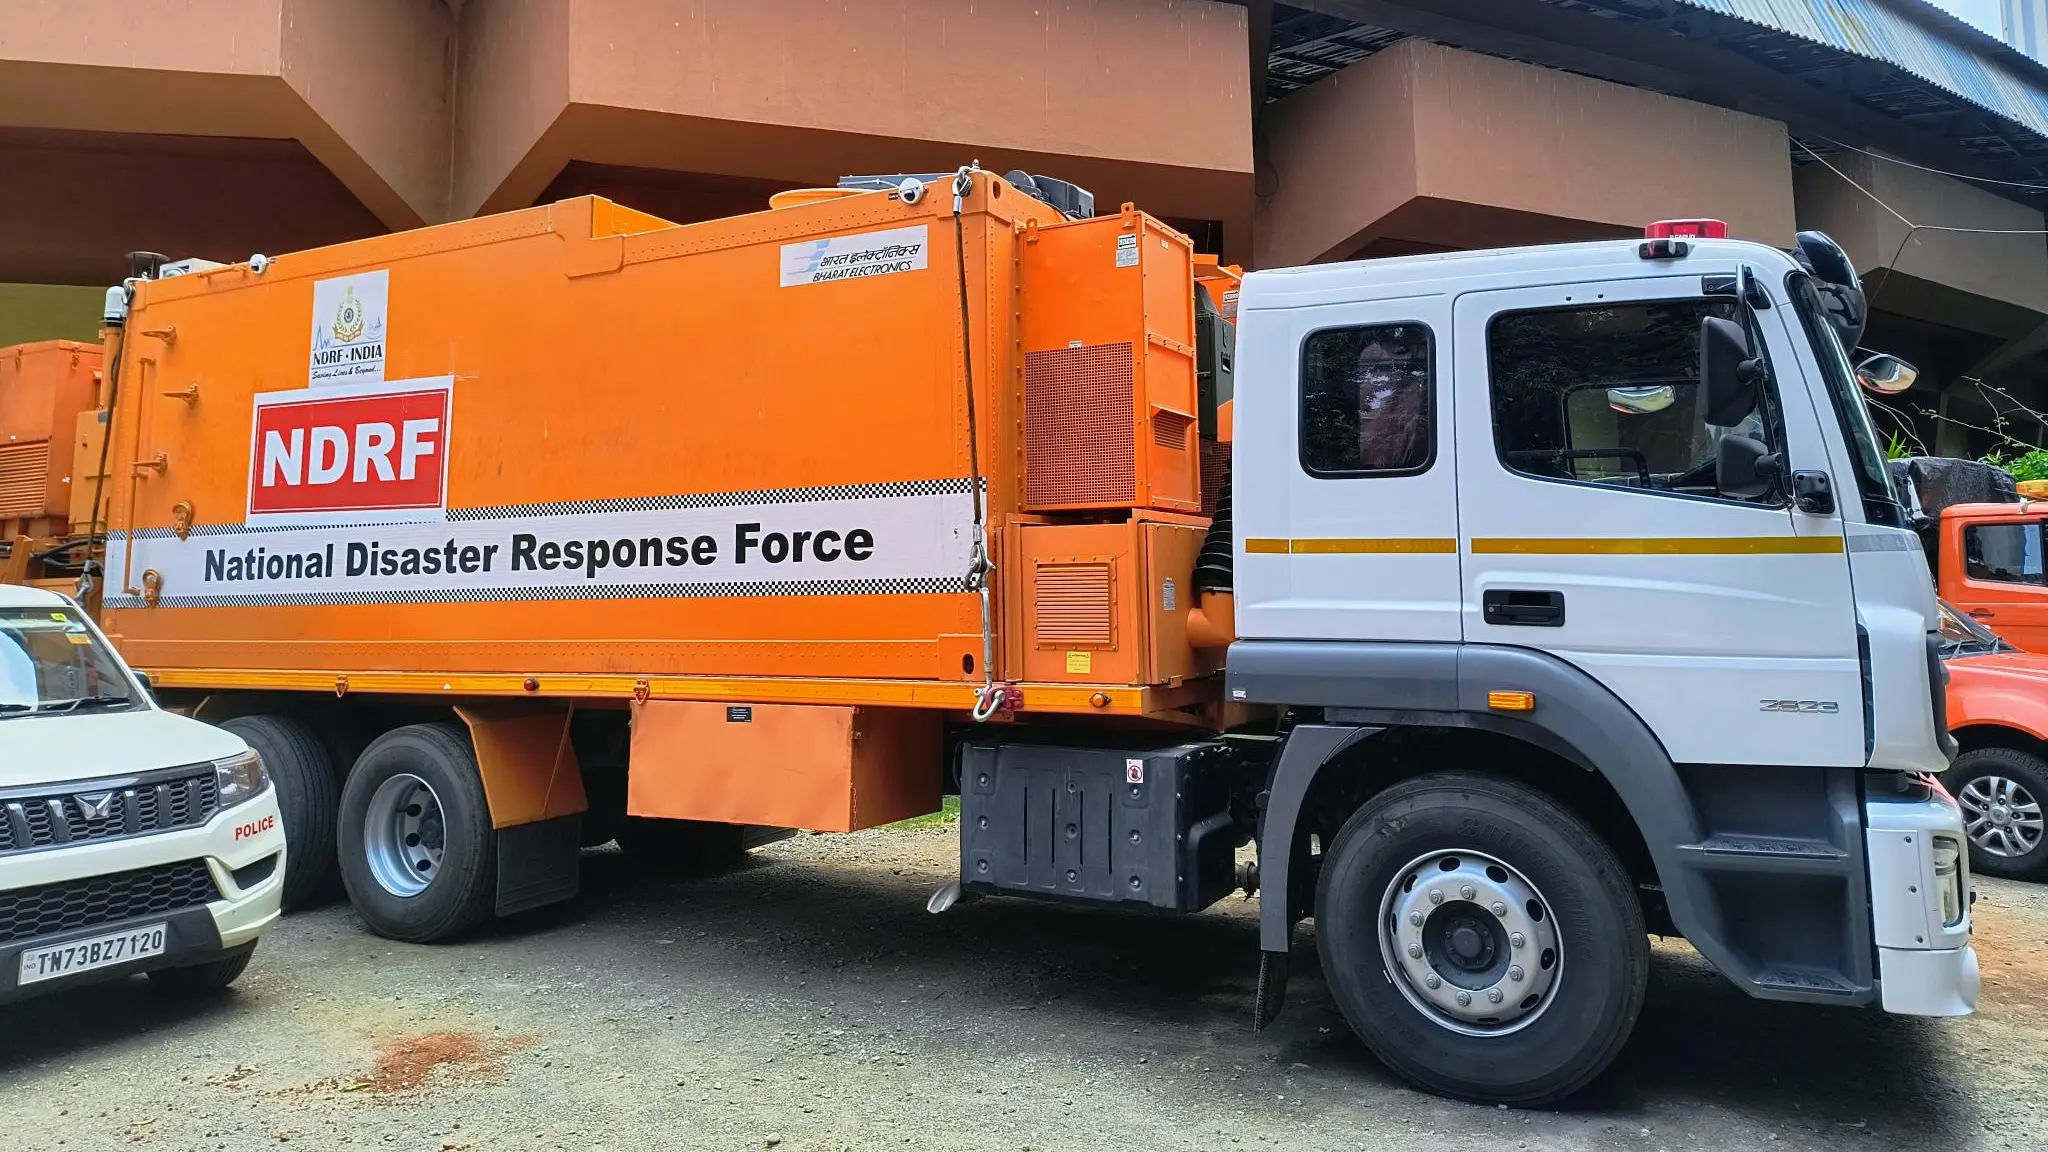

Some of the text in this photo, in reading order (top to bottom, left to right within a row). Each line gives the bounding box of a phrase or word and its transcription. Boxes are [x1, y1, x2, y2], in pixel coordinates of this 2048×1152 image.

[813, 260, 912, 282] BHARAT ELECTRONICS
[820, 253, 849, 267] भारत
[313, 345, 382, 365] NDRF INDIA
[262, 418, 439, 487] NDRF
[204, 522, 874, 582] National Disaster Response Force
[1759, 699, 1839, 714] 2823
[235, 815, 274, 841] POLICE
[38, 929, 163, 975] TN73BZ7120
